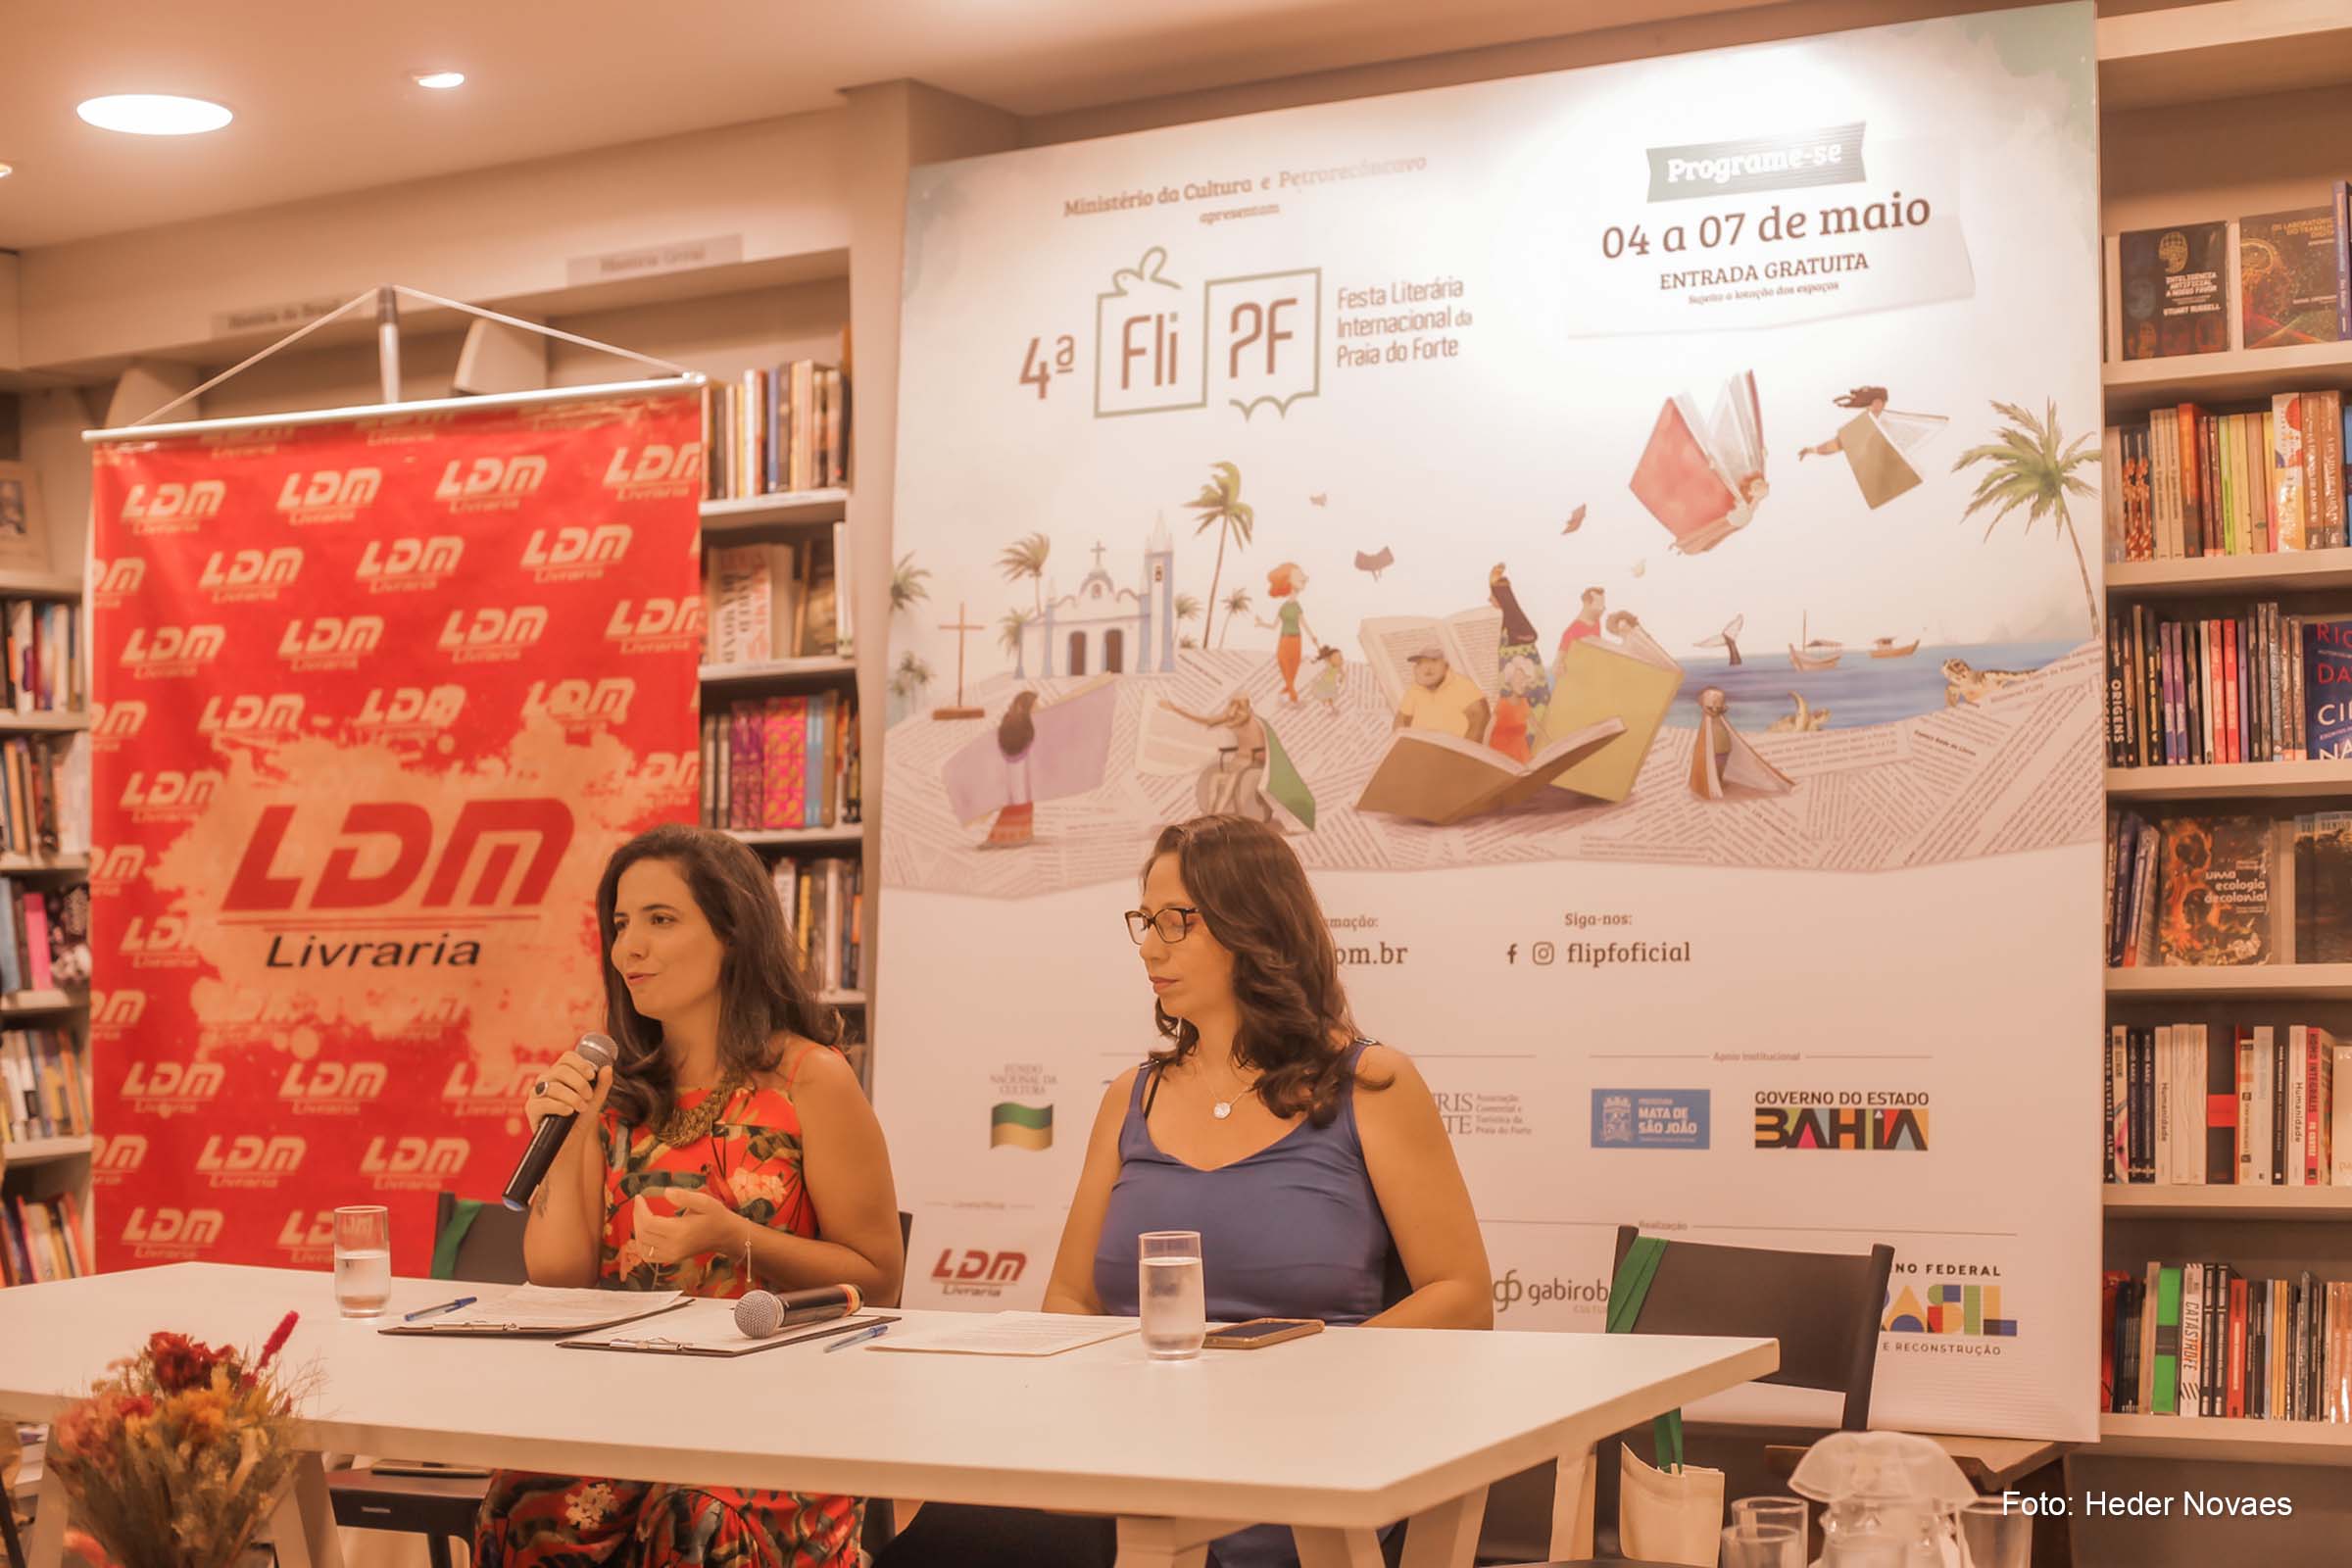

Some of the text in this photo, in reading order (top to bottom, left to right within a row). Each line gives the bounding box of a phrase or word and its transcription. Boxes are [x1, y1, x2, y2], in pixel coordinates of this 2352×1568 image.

[1667, 143, 1841, 183] Programe-se
[1064, 190, 1154, 218] Ministério
[1157, 186, 1180, 204] da
[1184, 177, 1252, 201] Cultura
[1260, 176, 1271, 191] e
[1601, 191, 1932, 259] 04 a 07 de maio
[1660, 253, 1869, 290] ENTRADA GRATUITA
[1776, 285, 1794, 295] dos
[1796, 281, 1839, 295] espaços
[1338, 275, 1464, 310] Festa Literária
[1337, 305, 1473, 338] Internacional da
[1020, 334, 1075, 401] 4ª
[1121, 312, 1179, 391] Fli
[1337, 337, 1459, 368] Praia do Forte
[276, 467, 381, 509] LDM
[435, 455, 548, 499] LDM
[121, 480, 226, 519] LDM
[356, 536, 465, 580] LDM
[520, 524, 632, 567] LDM
[199, 547, 304, 588] LDM
[120, 624, 225, 666] LDM
[277, 615, 384, 658] LDM
[438, 606, 549, 649] LDM
[2317, 662, 2352, 684] DA
[198, 693, 305, 733] LDM
[2111, 678, 2125, 743] ORIGENS
[220, 797, 575, 911] LDM
[2205, 870, 2236, 880] uma
[2215, 879, 2266, 892] ecologia
[2204, 890, 2268, 904] decolonial
[1327, 914, 1379, 931] mação:
[1564, 912, 1633, 929] Siga-nos:
[265, 932, 482, 969] Livraria
[1568, 942, 1690, 968] flipfoficial
[121, 1061, 225, 1098] LDM
[278, 1061, 388, 1099] LDM
[1755, 1091, 1929, 1105] GOVERNO DO ESTADO
[1639, 1107, 1689, 1119] MATA DE
[1639, 1120, 1697, 1134] SÃO JOÃO
[1755, 1107, 1929, 1151] BAHIA
[196, 1135, 306, 1172] LDM
[360, 1136, 470, 1173] LDM
[121, 1206, 224, 1244] LDM
[932, 1249, 1027, 1282] LDM
[1926, 1264, 2000, 1277] FEDERAL
[942, 1284, 1002, 1298] Livraria
[1883, 1285, 2017, 1337] ASIL
[1895, 1343, 2001, 1356] RECONSTRUÇÃO
